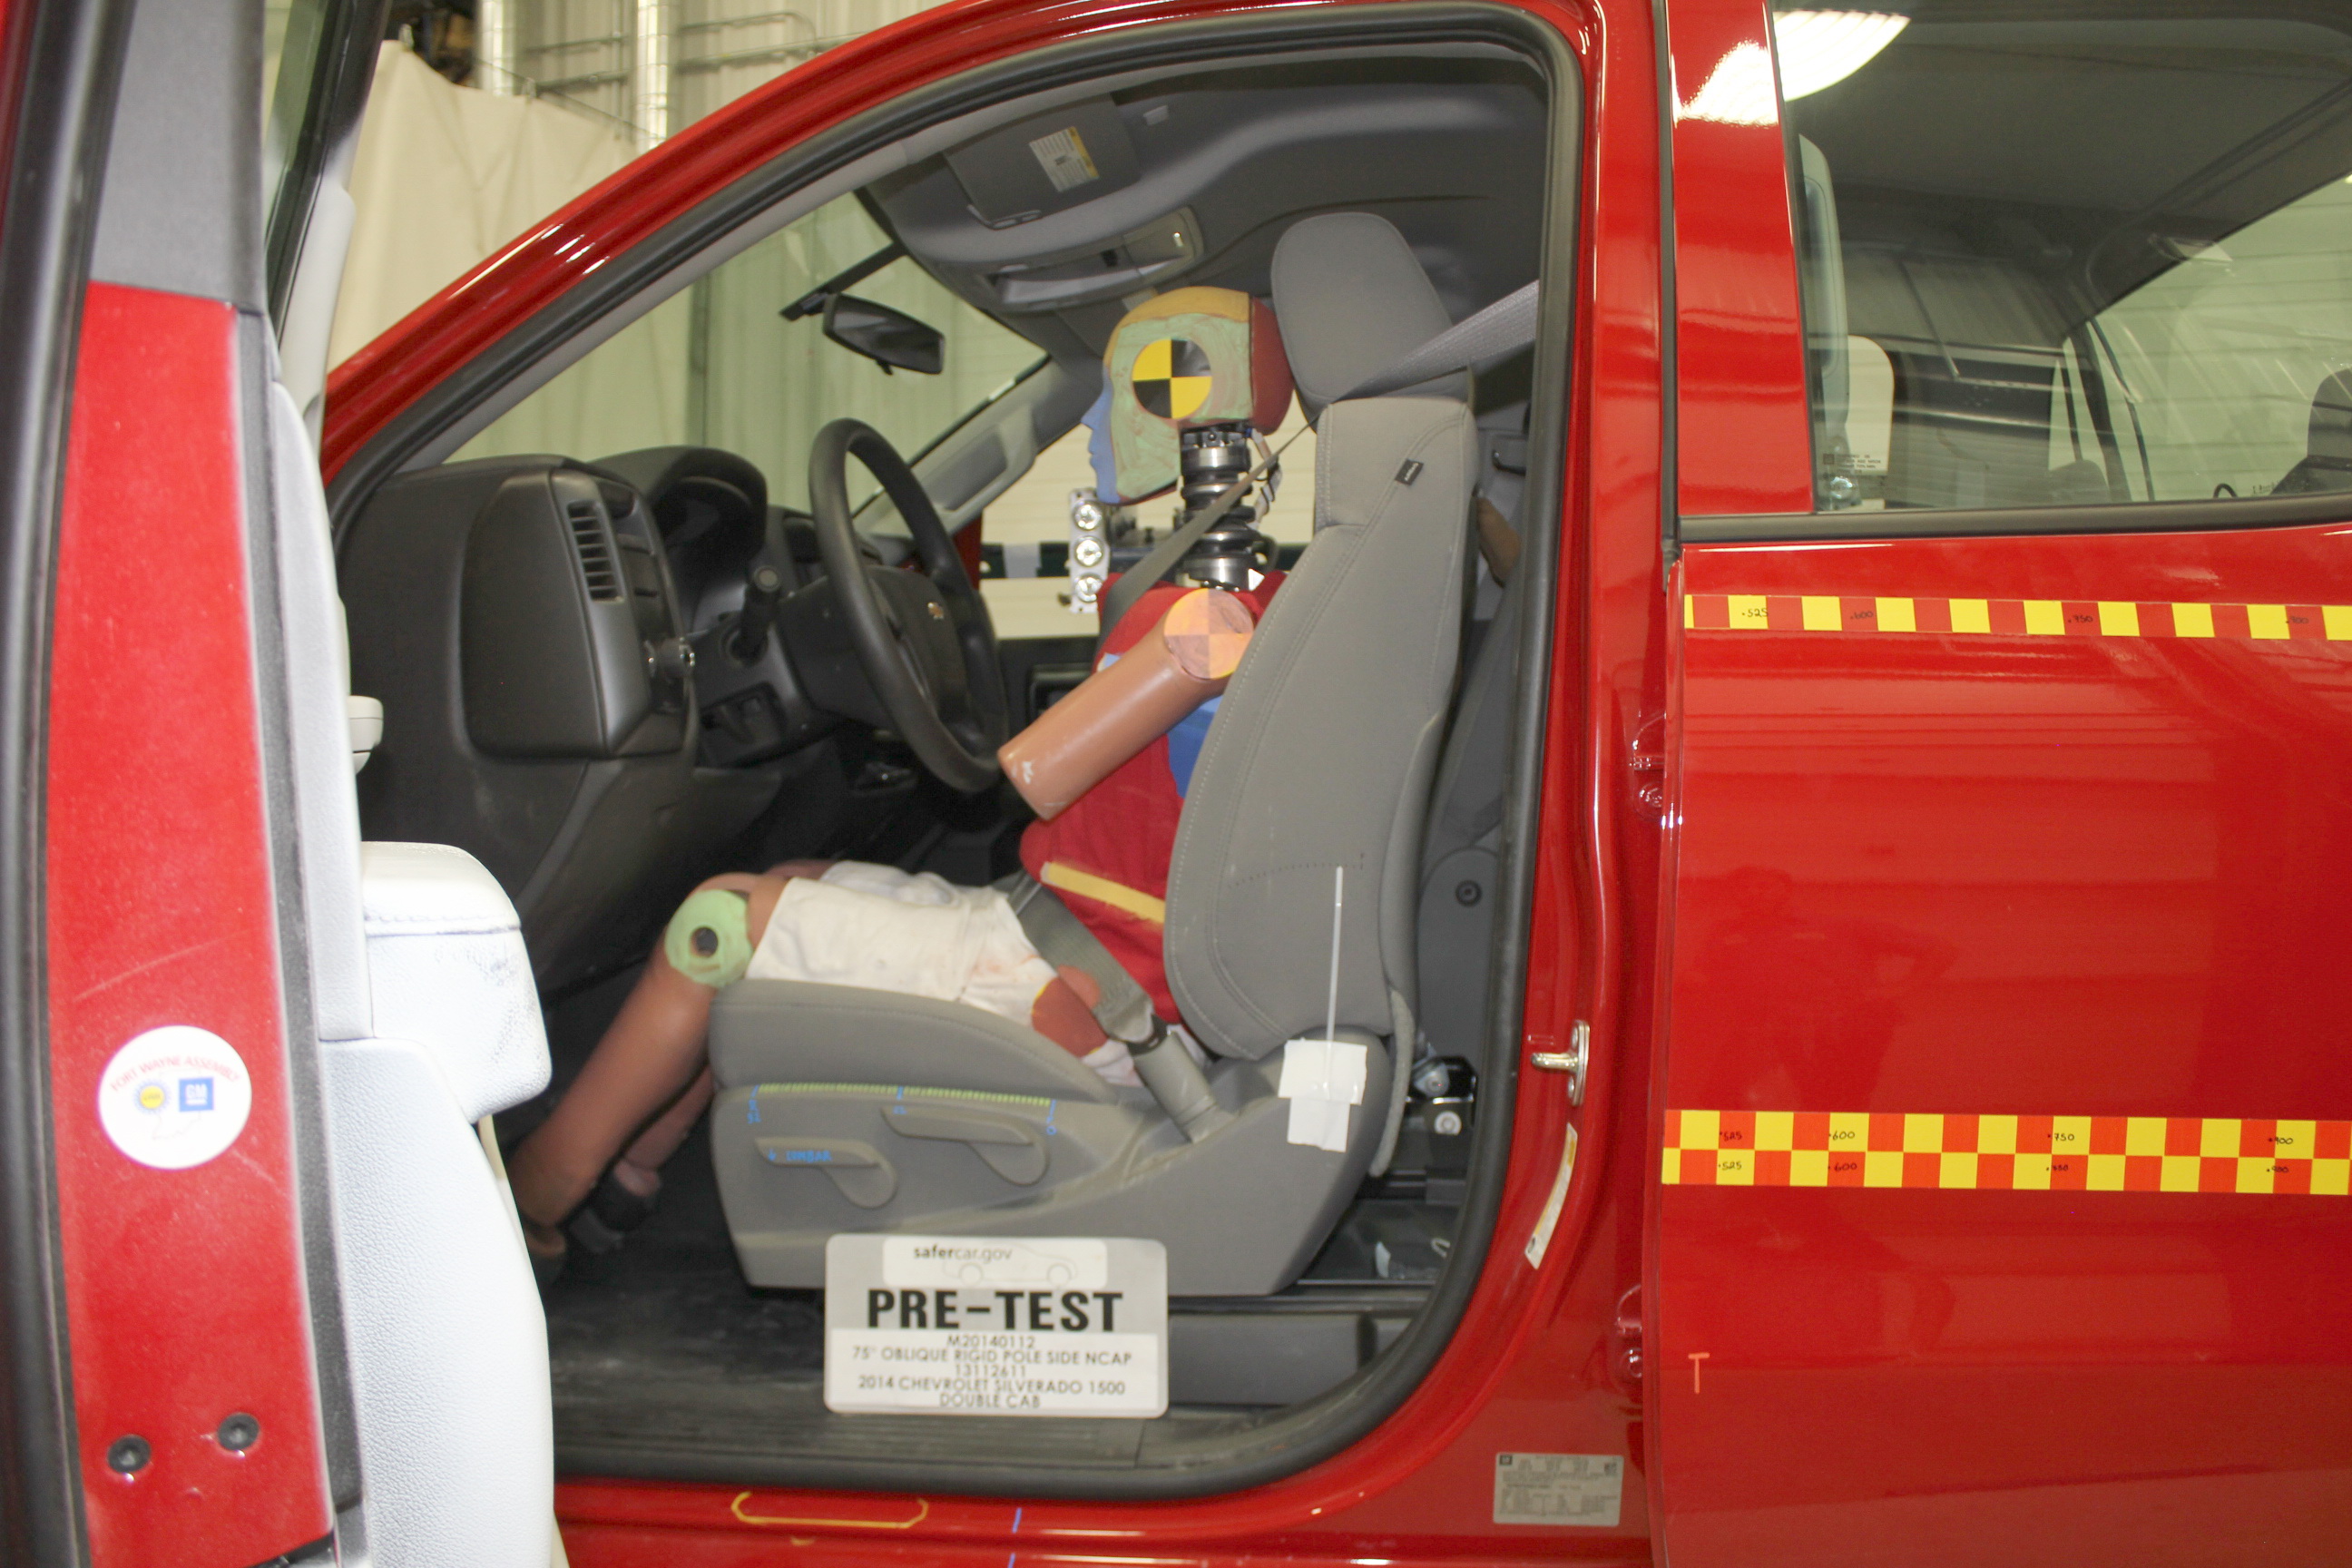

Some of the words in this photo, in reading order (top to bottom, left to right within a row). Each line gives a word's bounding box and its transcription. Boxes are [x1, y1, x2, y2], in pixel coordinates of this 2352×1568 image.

[111, 1068, 138, 1092] FORT
[139, 1055, 181, 1073] WAYNE
[185, 1055, 240, 1082] ASSEMBLY
[914, 1243, 1013, 1263] safercar.gov
[867, 1289, 1123, 1332] PRE-TEST
[946, 1335, 1035, 1348] M20140112
[881, 1347, 948, 1361] OBLIQUE
[955, 1348, 997, 1362] RIGID
[1003, 1349, 1042, 1364] POLE
[1046, 1350, 1081, 1365] SIDE
[1085, 1351, 1132, 1366] NCAP
[956, 1363, 1026, 1377] 13112611
[858, 1374, 895, 1389] 2014
[898, 1376, 988, 1392] CHEVROLET
[995, 1378, 1083, 1394] SILVERADO
[1090, 1380, 1126, 1395] 1500
[940, 1392, 999, 1407] DOUBLE
[1005, 1394, 1041, 1408] CAB
